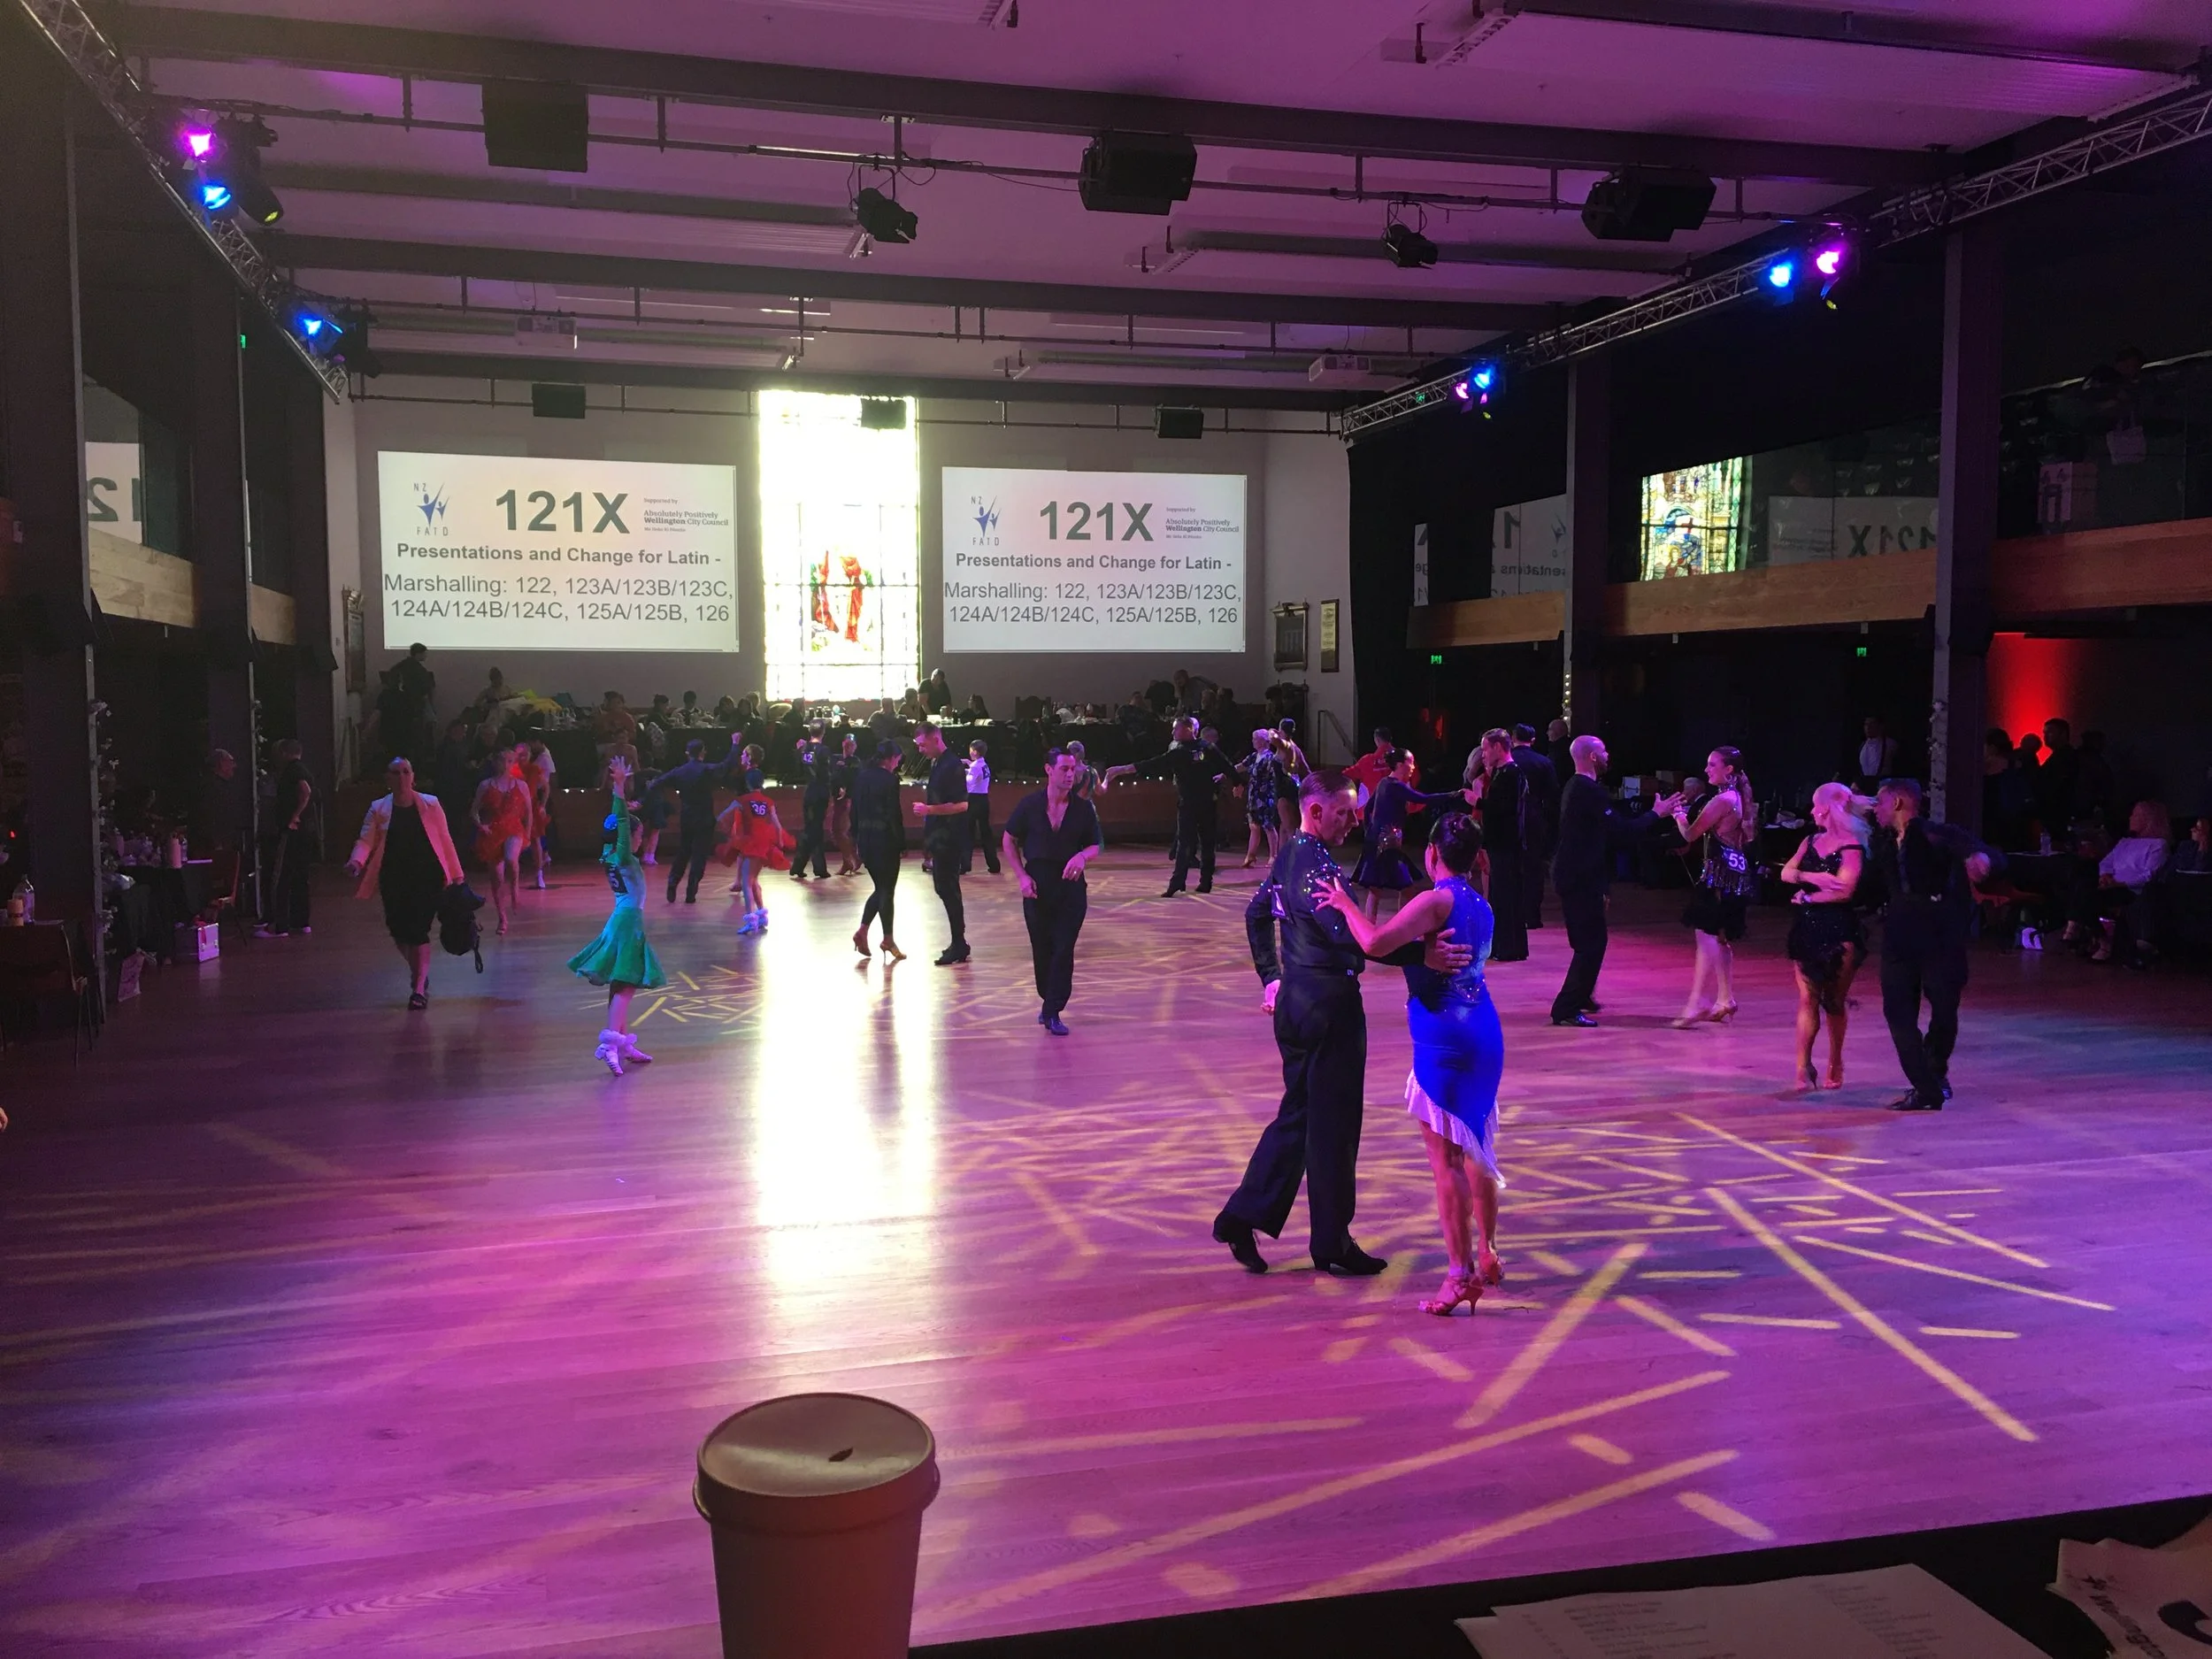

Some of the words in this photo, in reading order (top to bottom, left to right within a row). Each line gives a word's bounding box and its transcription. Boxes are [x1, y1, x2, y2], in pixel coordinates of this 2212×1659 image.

[496, 489, 630, 534] 121X
[684, 511, 718, 519] Positively
[1041, 502, 1154, 541] 121X
[398, 543, 522, 560] Presentations
[529, 548, 560, 560] and
[567, 548, 633, 565] Change
[639, 549, 663, 563] for
[669, 550, 709, 565] Latin
[956, 553, 1062, 567] Presentations
[1067, 556, 1094, 567] and
[1100, 556, 1156, 572] Change
[1160, 557, 1180, 569] for
[1187, 557, 1221, 569] Latin
[385, 574, 506, 596] Marshalling:
[517, 577, 556, 595] 122,
[566, 579, 732, 599] 123A/123B/123C,
[945, 582, 1047, 602] Marshalling:
[1056, 583, 1089, 601] 122,
[1098, 584, 1240, 602] 123A/123B/123C,
[392, 600, 567, 620] 124A/124B/124C,
[578, 603, 687, 623] 125A/125B,
[696, 605, 728, 621] 126
[950, 606, 1098, 624] 124A/124B/124C,
[1107, 607, 1201, 625] 125A/125B,
[1210, 608, 1237, 623] 126
[1728, 852, 1746, 871] 53
